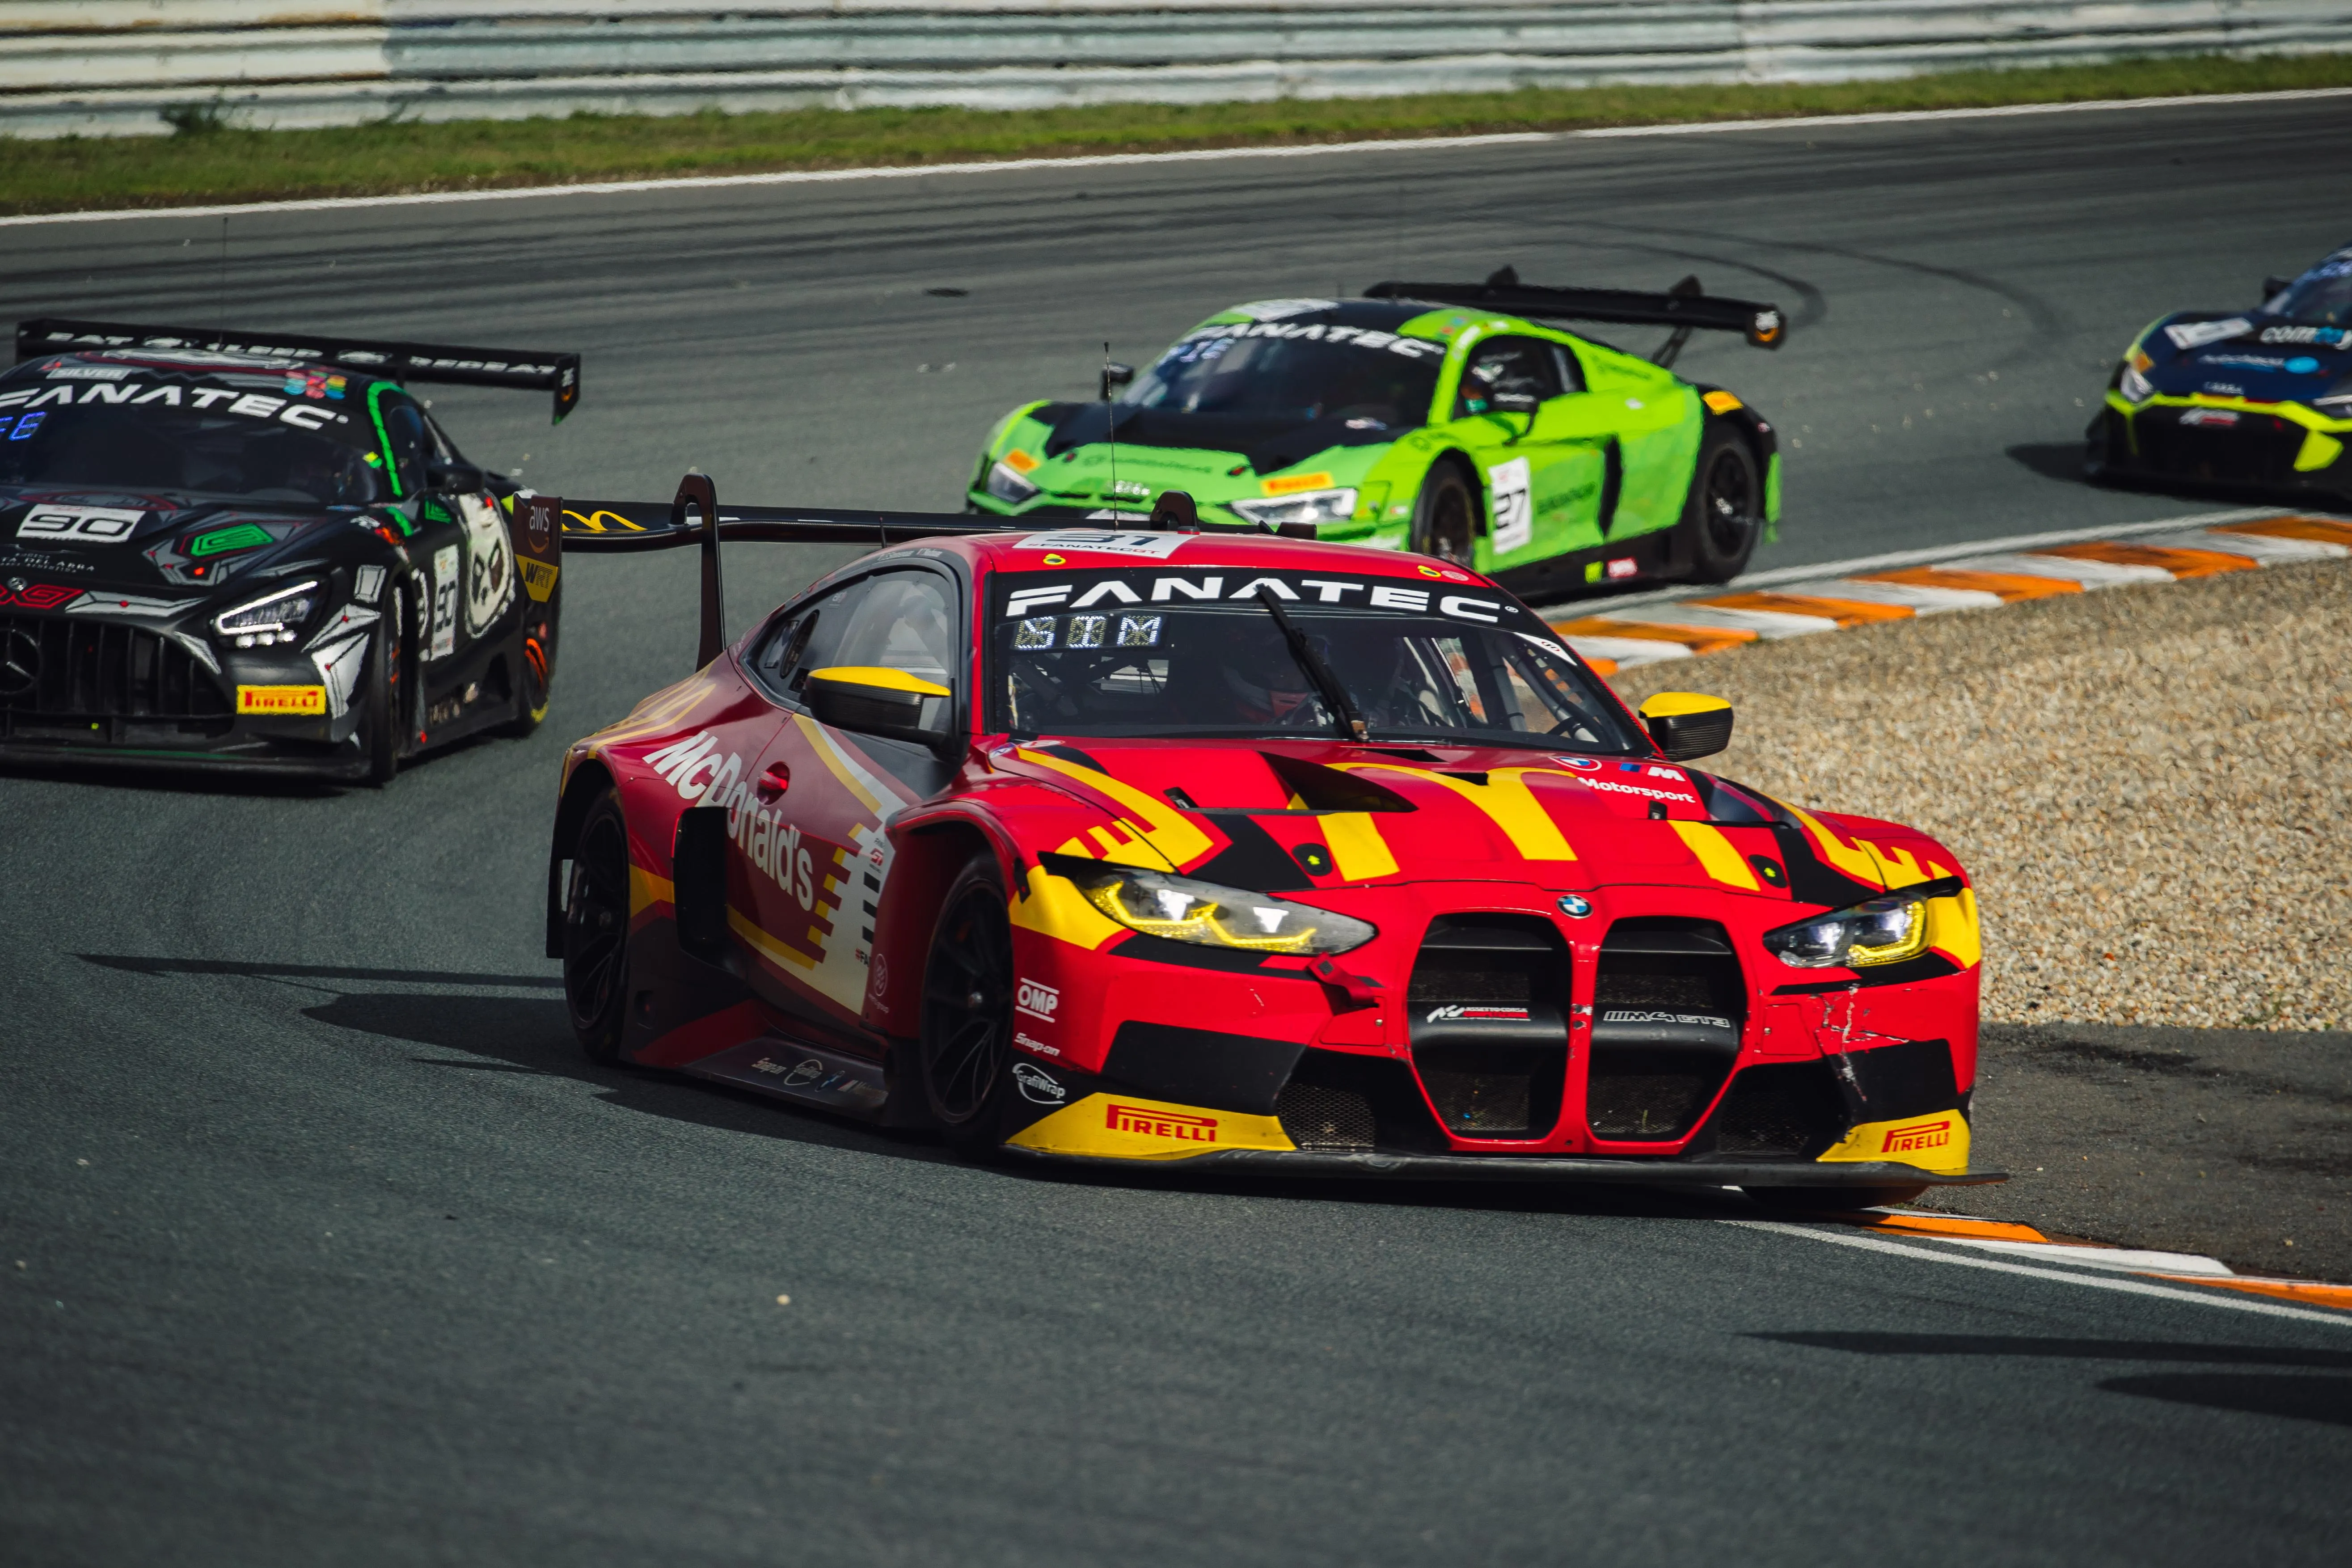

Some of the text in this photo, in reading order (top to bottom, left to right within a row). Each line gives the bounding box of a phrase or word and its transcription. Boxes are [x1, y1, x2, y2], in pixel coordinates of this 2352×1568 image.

[56, 369, 123, 377] SILVER
[22, 514, 133, 536] 90
[529, 505, 550, 532] aws
[1027, 543, 1161, 554] #FANATECGT
[1044, 533, 1160, 546] 31
[525, 562, 553, 589] WRT
[1005, 577, 1501, 623] FANATEC
[1013, 615, 1161, 650] SIM
[245, 690, 318, 707] PIRELLI
[1576, 777, 1696, 803] Motorsport
[642, 730, 814, 912] McDonald's
[1018, 985, 1058, 1014] OMP
[1676, 1014, 1731, 1028] GT3
[1014, 1032, 1060, 1057] Snap-on
[1016, 1069, 1066, 1099] GrafiWrap
[1106, 1103, 1219, 1142] PIRELLI
[1881, 1120, 1951, 1153] PIRELLI
